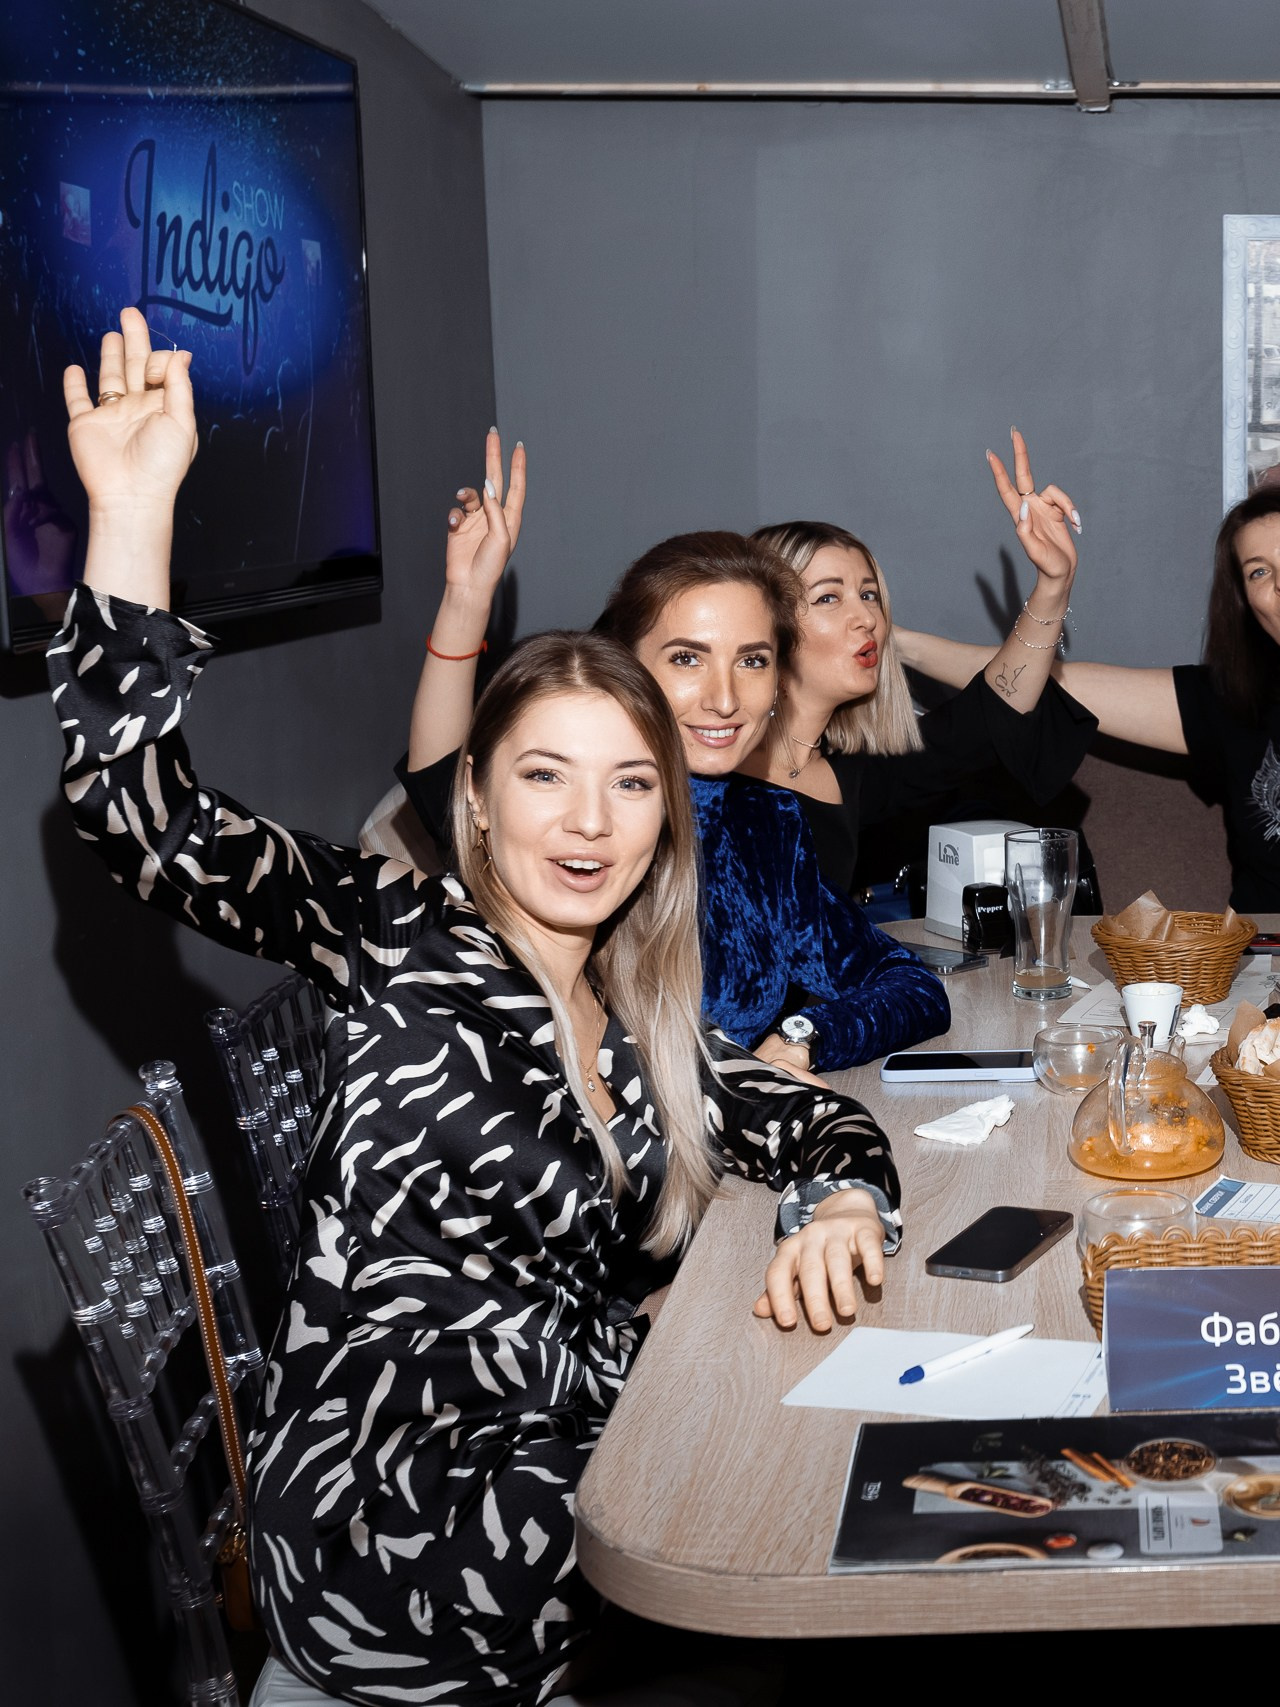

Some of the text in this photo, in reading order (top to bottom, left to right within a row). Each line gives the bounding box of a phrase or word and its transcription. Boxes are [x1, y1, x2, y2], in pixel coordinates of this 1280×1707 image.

[231, 180, 285, 231] SHOW
[124, 138, 286, 377] Indigo
[938, 841, 960, 866] Lime
[977, 904, 1004, 914] Pepper
